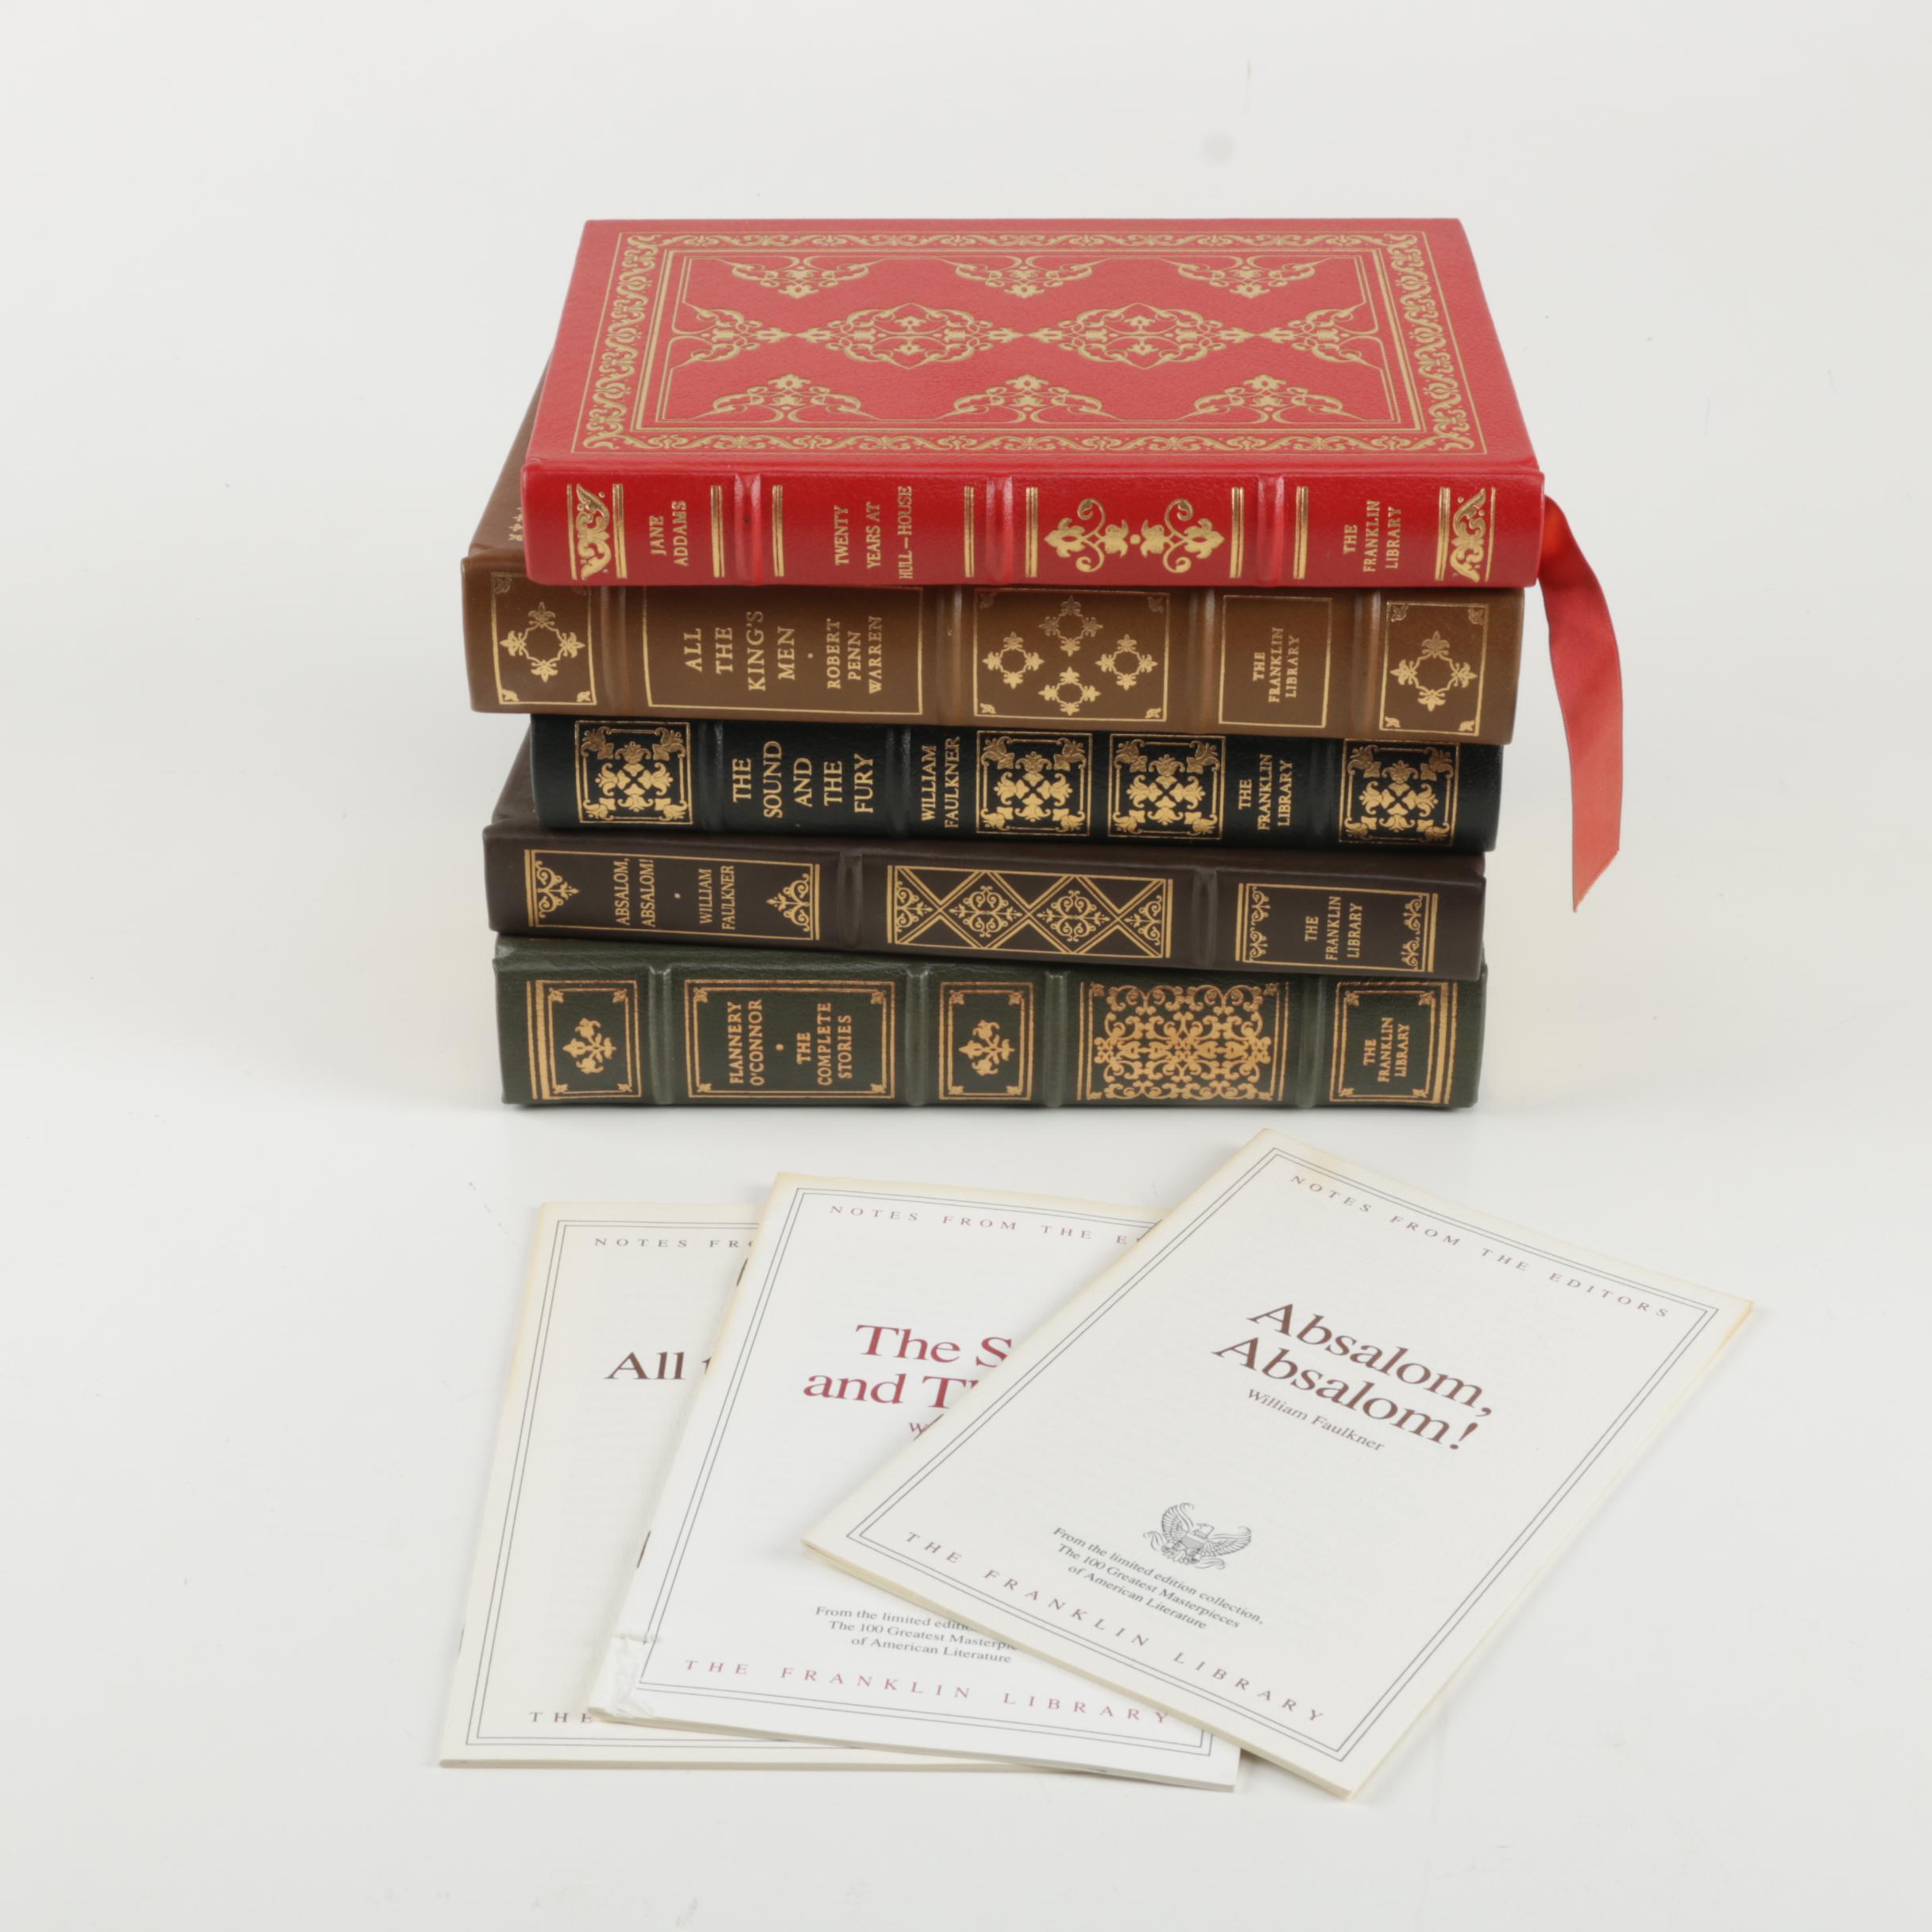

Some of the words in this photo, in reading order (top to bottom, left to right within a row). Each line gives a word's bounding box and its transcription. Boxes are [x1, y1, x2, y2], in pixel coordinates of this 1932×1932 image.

[650, 515, 665, 556] JANE
[672, 500, 690, 567] ADDAMS
[835, 504, 849, 566] TWENTY
[866, 501, 881, 523] AT
[1344, 524, 1357, 554] THE
[1362, 500, 1381, 573] FRANKLIN
[1385, 505, 1401, 570] LIBRARY
[866, 525, 882, 569] YEARS
[684, 628, 701, 673] ALL
[715, 627, 733, 674] THE
[748, 610, 766, 691] KING'S
[778, 626, 796, 680] MEN
[827, 618, 841, 690] ROBERT
[848, 631, 862, 681] PENN
[867, 616, 883, 694] WARREN
[1254, 651, 1266, 682] THE
[1268, 627, 1284, 703] FRANKLIN
[1285, 634, 1300, 698] LIBRARY
[732, 758, 752, 803] THE
[763, 740, 783, 819] SOUND
[794, 756, 813, 808] AND
[824, 760, 843, 806] THE
[854, 753, 874, 814] FURY
[922, 744, 937, 822] WILLIAM
[945, 736, 960, 829] FAULKNER
[1238, 779, 1253, 810] THE
[1258, 754, 1273, 831] FRANKLIN
[1277, 759, 1293, 827] LIBRARY
[614, 857, 630, 926] ABSALOM,
[641, 858, 656, 928] ABSALOM!
[699, 867, 713, 925] WILLIAM
[721, 864, 736, 931] FAULKNER
[1305, 916, 1319, 943] THE
[1325, 895, 1342, 961] FRANKLIN
[1347, 902, 1363, 958] LIBRARY
[728, 1001, 744, 1085] FLANNERY
[749, 998, 764, 1087] O'CONNOR
[797, 1032, 811, 1065] THE
[817, 1003, 833, 1087] COMPLETE
[838, 1014, 852, 1080] STORIES
[1363, 1037, 1377, 1066] THE
[1378, 1017, 1394, 1083] FRANKLIN
[1394, 1022, 1410, 1078] LIBRARY
[594, 1237, 687, 1248] NOTES
[829, 1205, 918, 1221] NOTES
[942, 1215, 1017, 1231] FROM
[1041, 1225, 1092, 1239] THE
[1290, 1175, 1372, 1214] NOTES
[1389, 1215, 1462, 1246] FROM
[1481, 1248, 1529, 1272] THE
[1548, 1273, 1669, 1318] EDITORS
[603, 1351, 687, 1381] All
[856, 1324, 960, 1363] The
[1246, 1304, 1492, 1417] Absalom,
[803, 1373, 906, 1404] and
[1211, 1337, 1479, 1451] Absalom!
[1247, 1389, 1309, 1421] William
[1310, 1414, 1385, 1451] Faulkner
[1053, 1527, 1087, 1548] From
[1088, 1543, 1108, 1557] the
[1109, 1552, 1154, 1576] limited
[1154, 1572, 1197, 1596] edition
[1199, 1590, 1264, 1625] collection,
[1057, 1543, 1081, 1559] The
[1082, 1555, 1106, 1571] 100
[1106, 1567, 1158, 1594] Greatest
[1159, 1587, 1240, 1629] Masterpieces
[1068, 1564, 1084, 1575] of
[1084, 1571, 1144, 1603] American
[1145, 1597, 1208, 1629] Literature
[815, 1605, 853, 1618] From
[856, 1609, 878, 1621] the
[882, 1611, 930, 1627] limited
[828, 1620, 856, 1632] The
[860, 1623, 883, 1634] 100
[887, 1626, 945, 1643] Greatest
[905, 1531, 964, 1564] THE
[982, 1568, 1150, 1648] FRANKLIN
[1173, 1651, 1325, 1723] LIBRARY
[851, 1636, 867, 1647] of
[870, 1637, 939, 1656] American
[942, 1645, 1011, 1663] Literature
[685, 1659, 749, 1675] THE
[780, 1667, 971, 1699] FRANKLIN
[1003, 1692, 1169, 1724] LIBRARY
